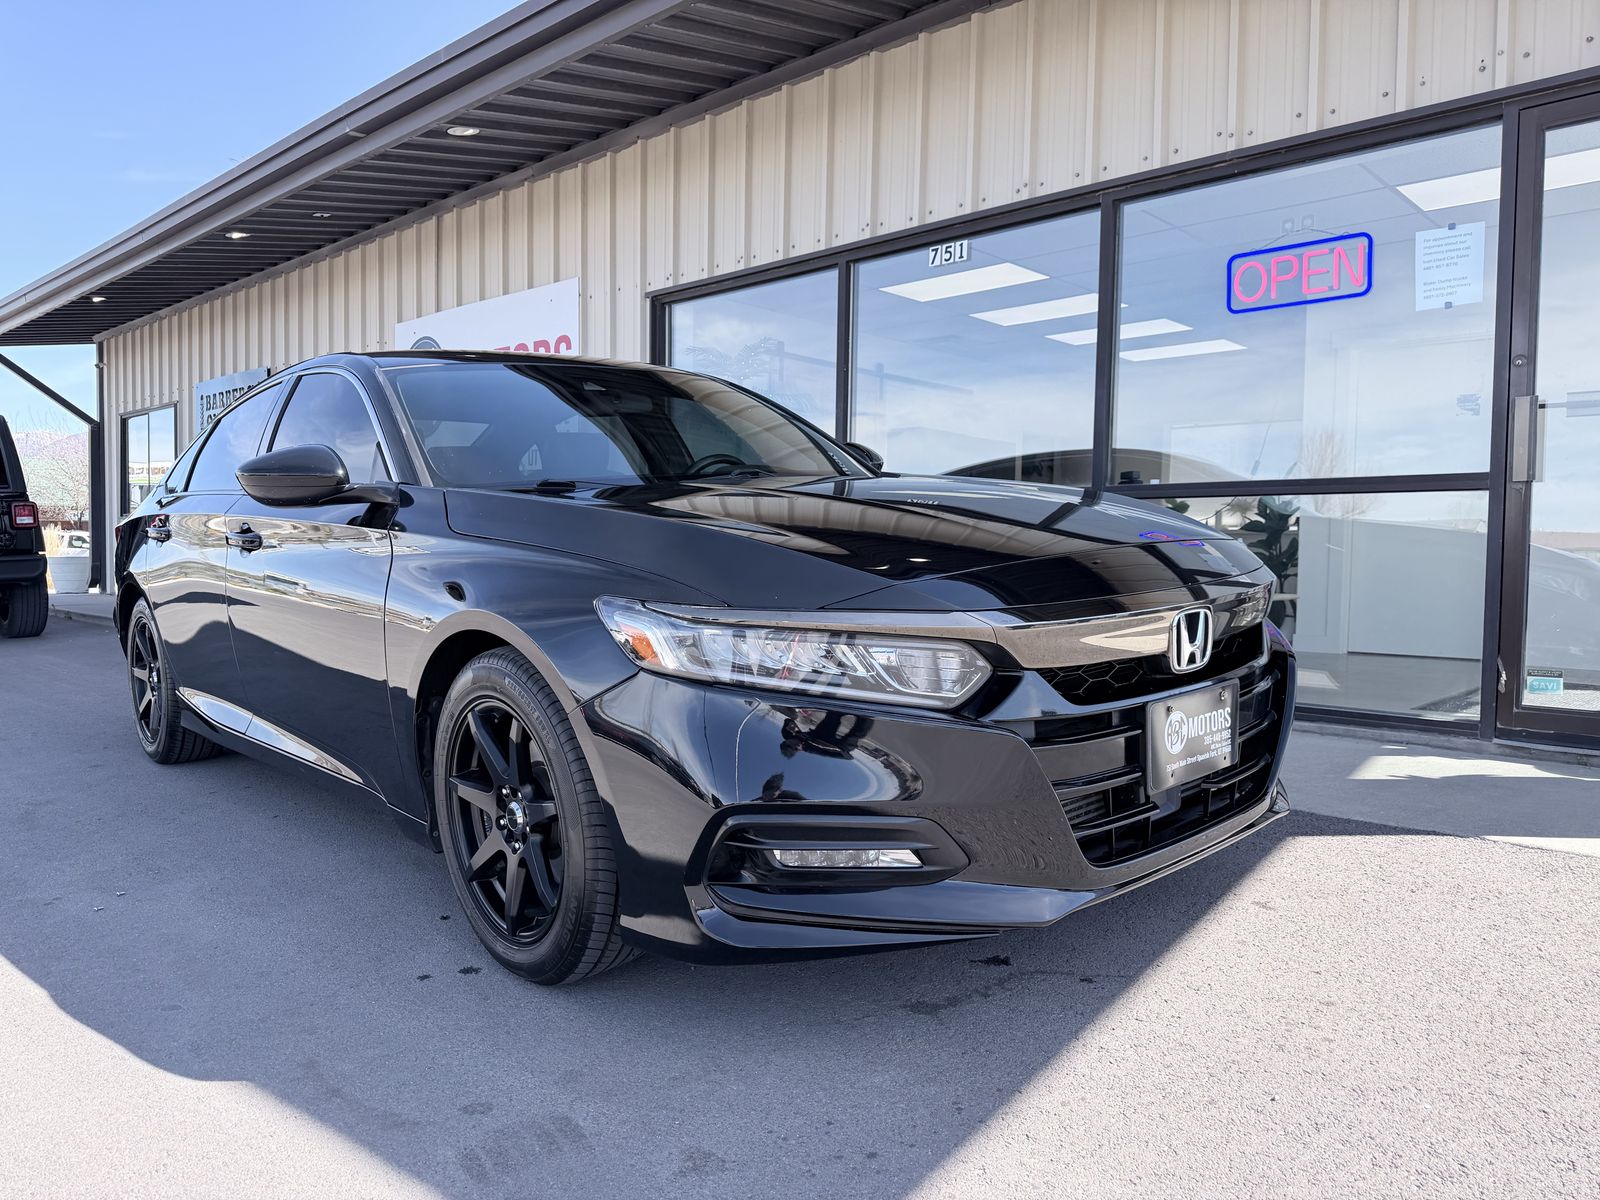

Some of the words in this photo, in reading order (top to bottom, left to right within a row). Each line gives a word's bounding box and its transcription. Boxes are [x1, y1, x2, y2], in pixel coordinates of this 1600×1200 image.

[930, 242, 965, 265] 751
[1233, 243, 1365, 303] OPEN
[1188, 707, 1232, 739] MOTORS
